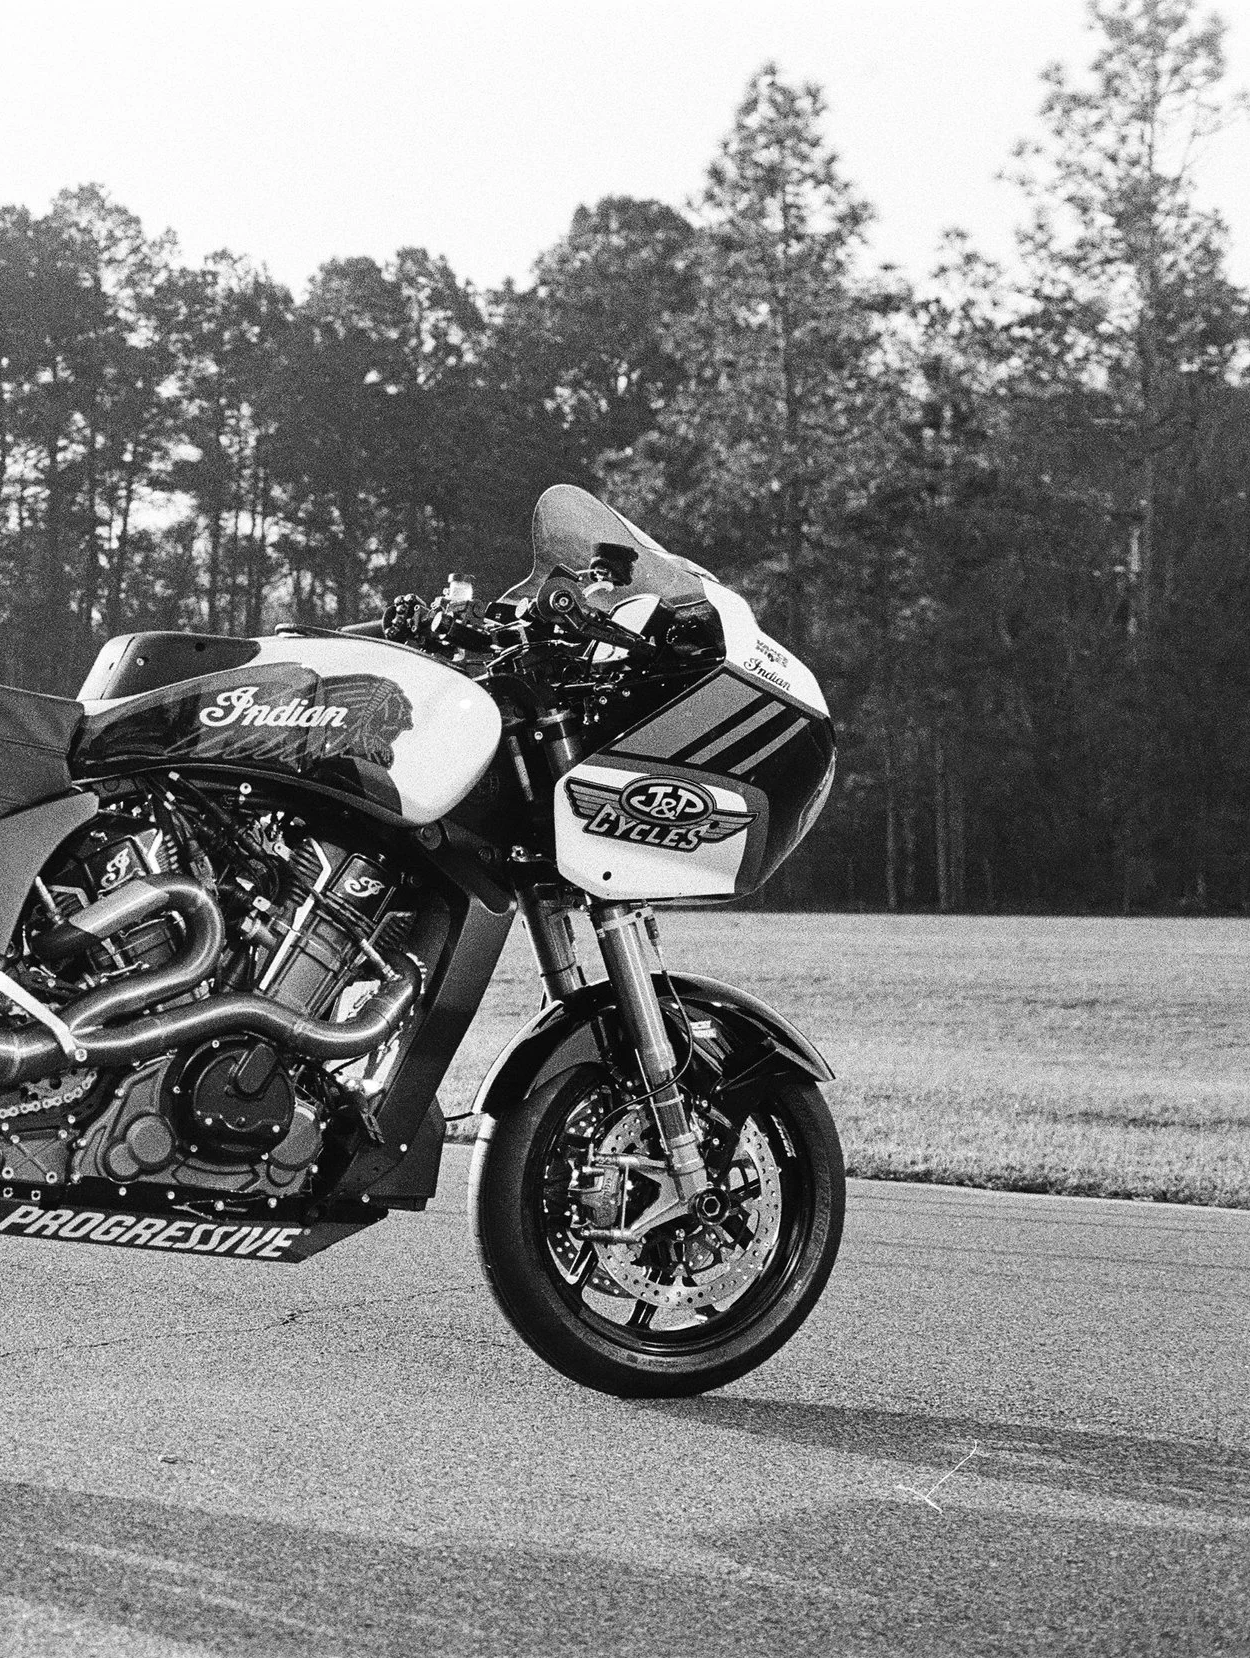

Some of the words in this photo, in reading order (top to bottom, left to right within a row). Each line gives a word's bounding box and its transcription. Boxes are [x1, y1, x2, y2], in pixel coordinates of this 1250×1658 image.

[743, 657, 791, 691] Indian
[199, 686, 349, 727] Indian
[629, 786, 705, 821] J&P
[587, 803, 713, 851] CYCLES
